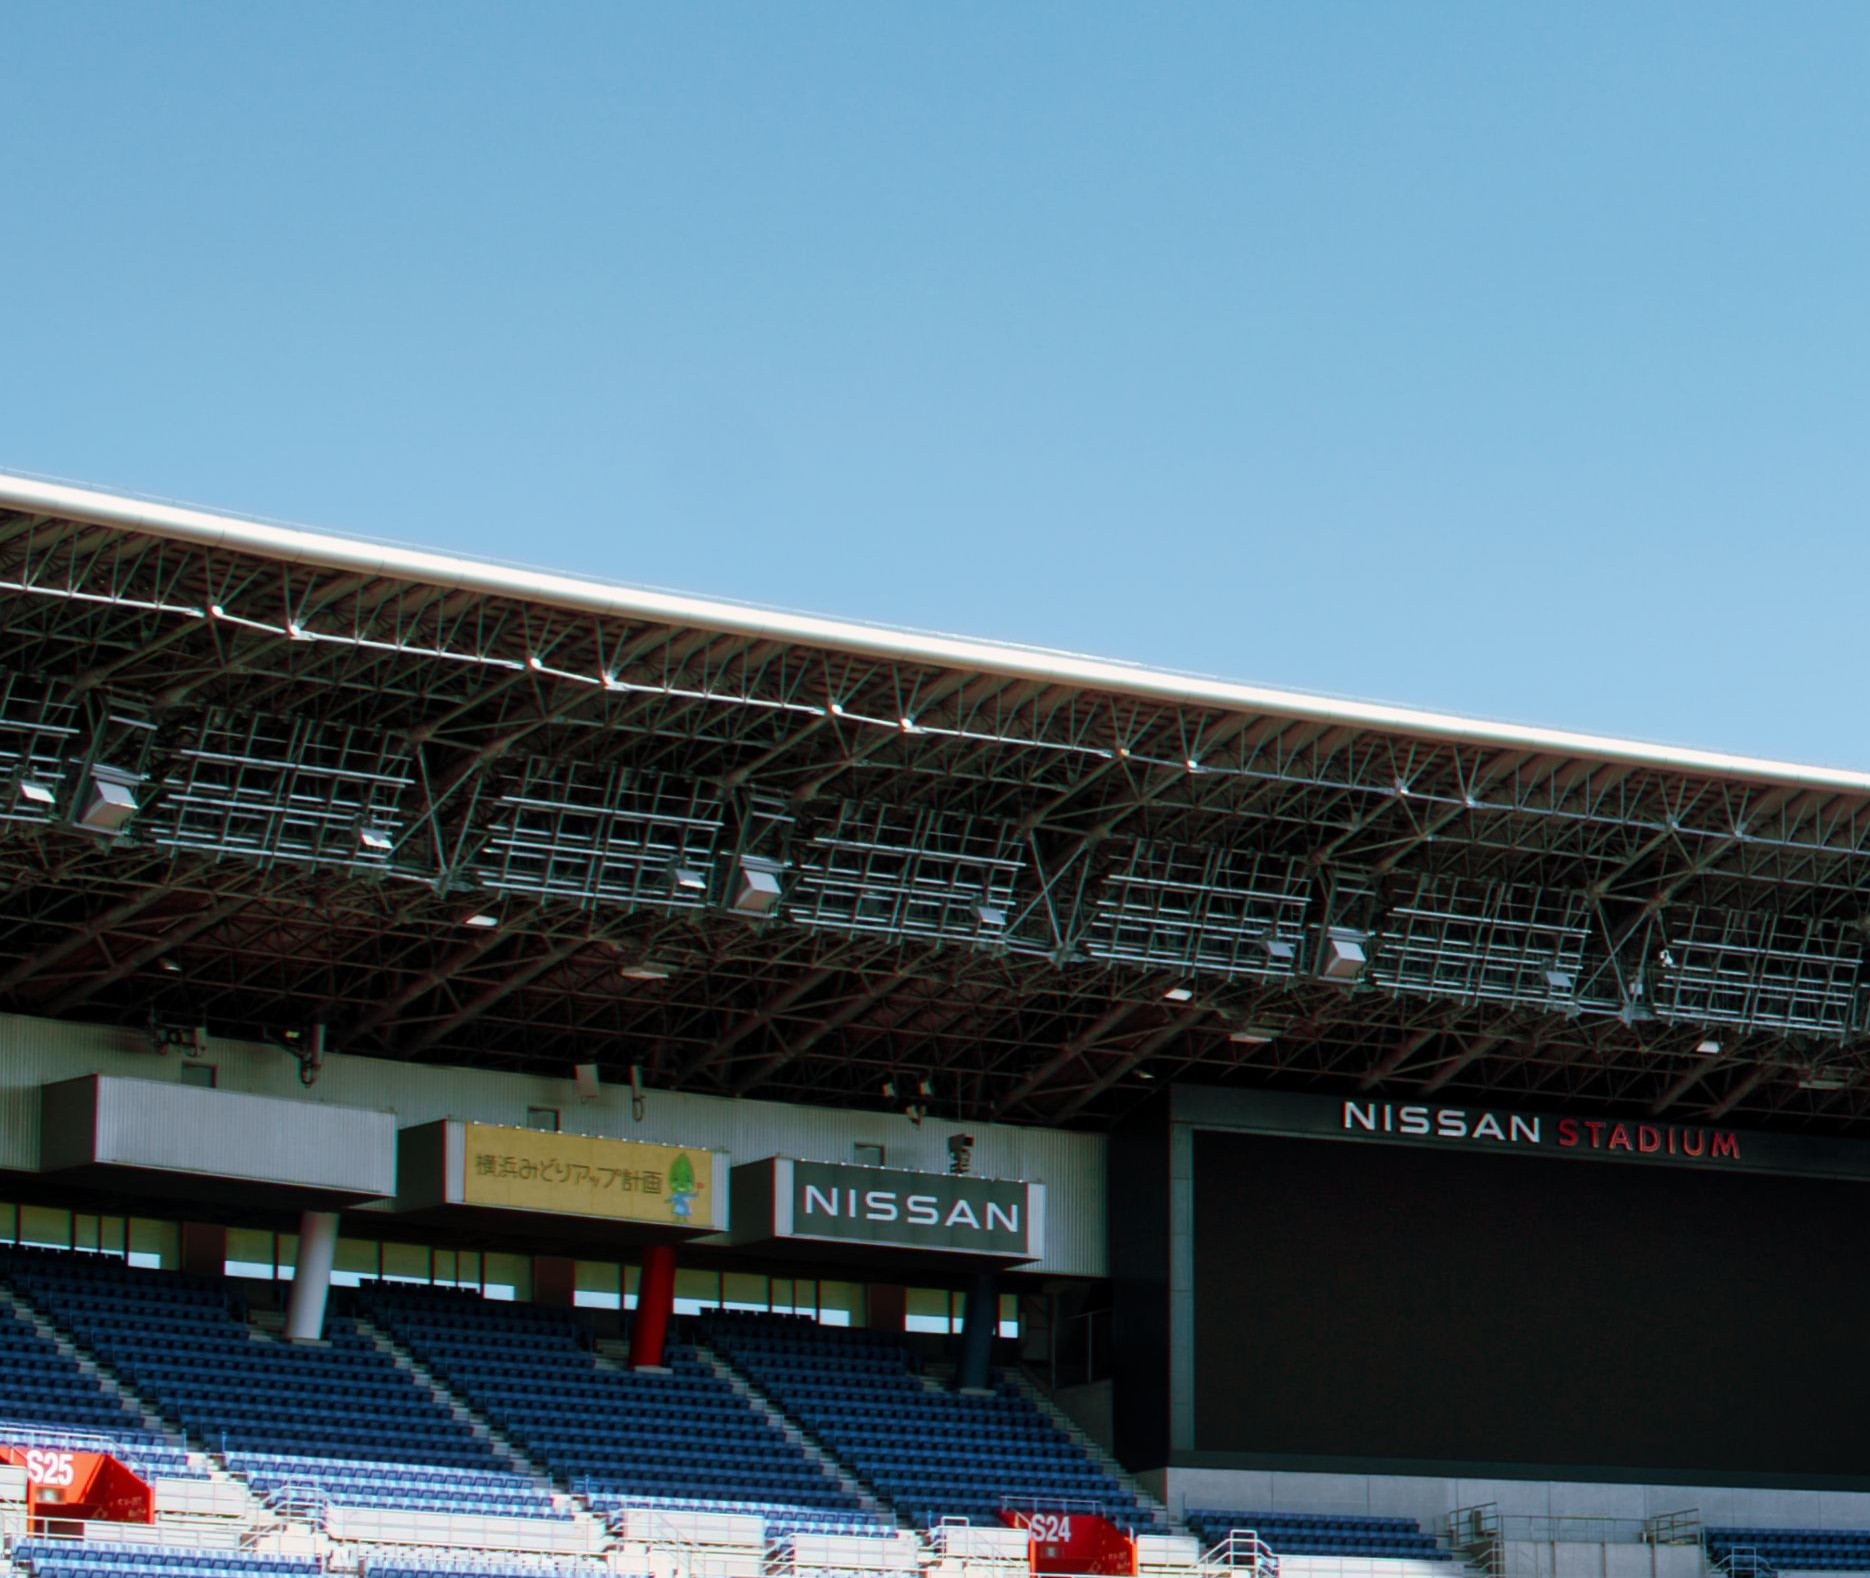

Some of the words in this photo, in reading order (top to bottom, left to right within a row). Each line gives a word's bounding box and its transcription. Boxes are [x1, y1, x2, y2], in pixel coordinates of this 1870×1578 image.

[1344, 1101, 1540, 1143] NISSAN
[1558, 1119, 1740, 1159] STADIUM
[475, 1153, 664, 1195] 横浜みどりアップ計画
[804, 1184, 1020, 1233] NISSAN
[26, 1451, 74, 1486] S25
[1030, 1514, 1071, 1543] S24
